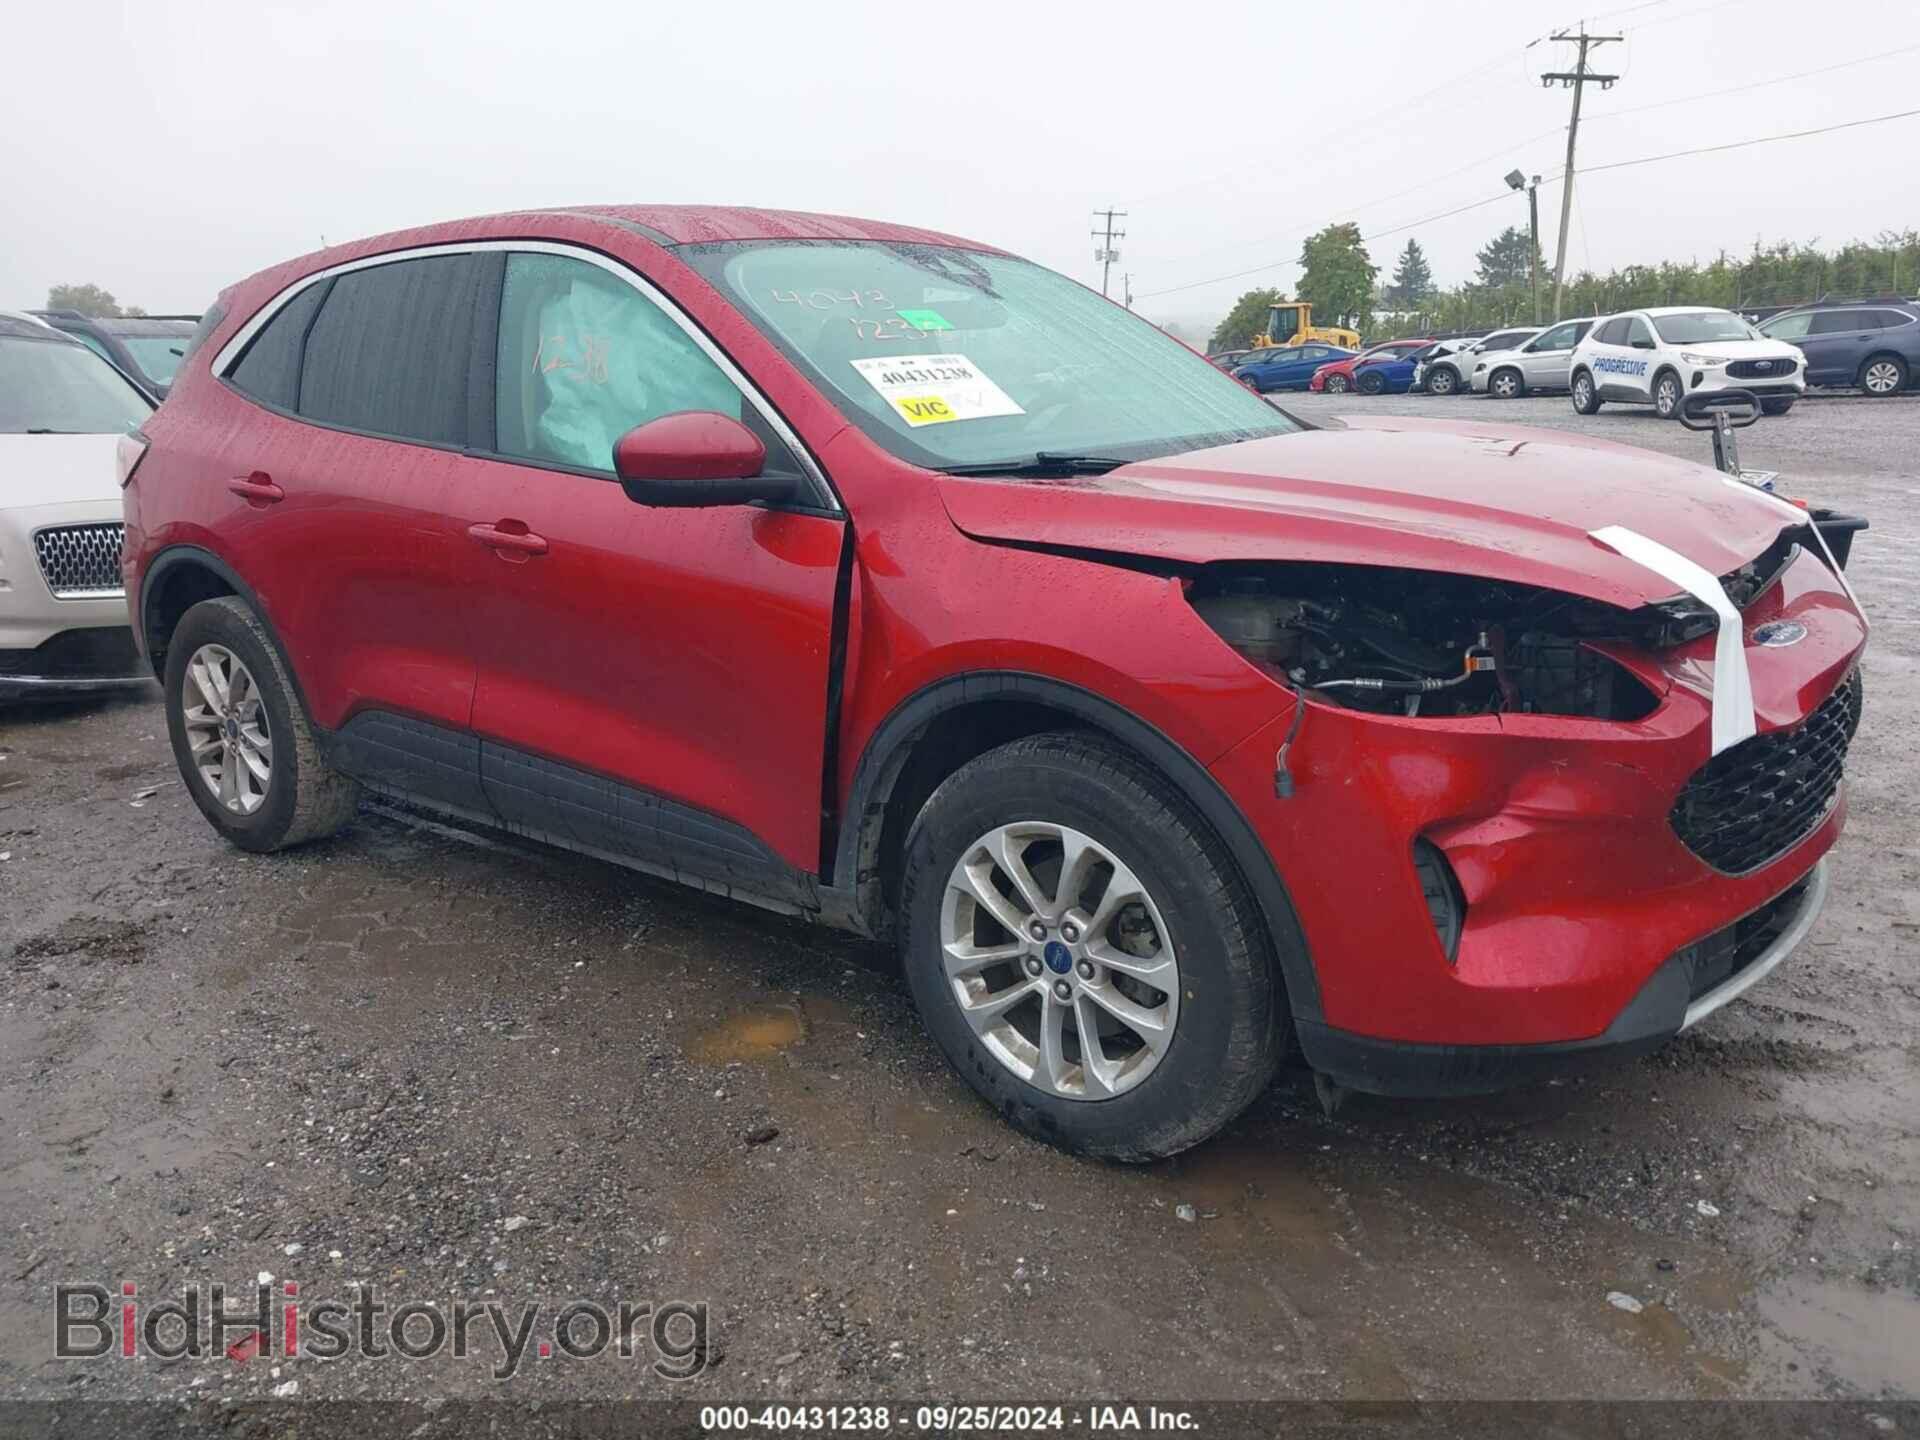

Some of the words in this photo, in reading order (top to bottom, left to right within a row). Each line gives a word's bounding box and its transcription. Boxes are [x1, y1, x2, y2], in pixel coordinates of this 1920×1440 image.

[881, 367, 973, 385] 40431238
[1592, 357, 1648, 377] PROGRESSIVE
[902, 401, 949, 417] VIC
